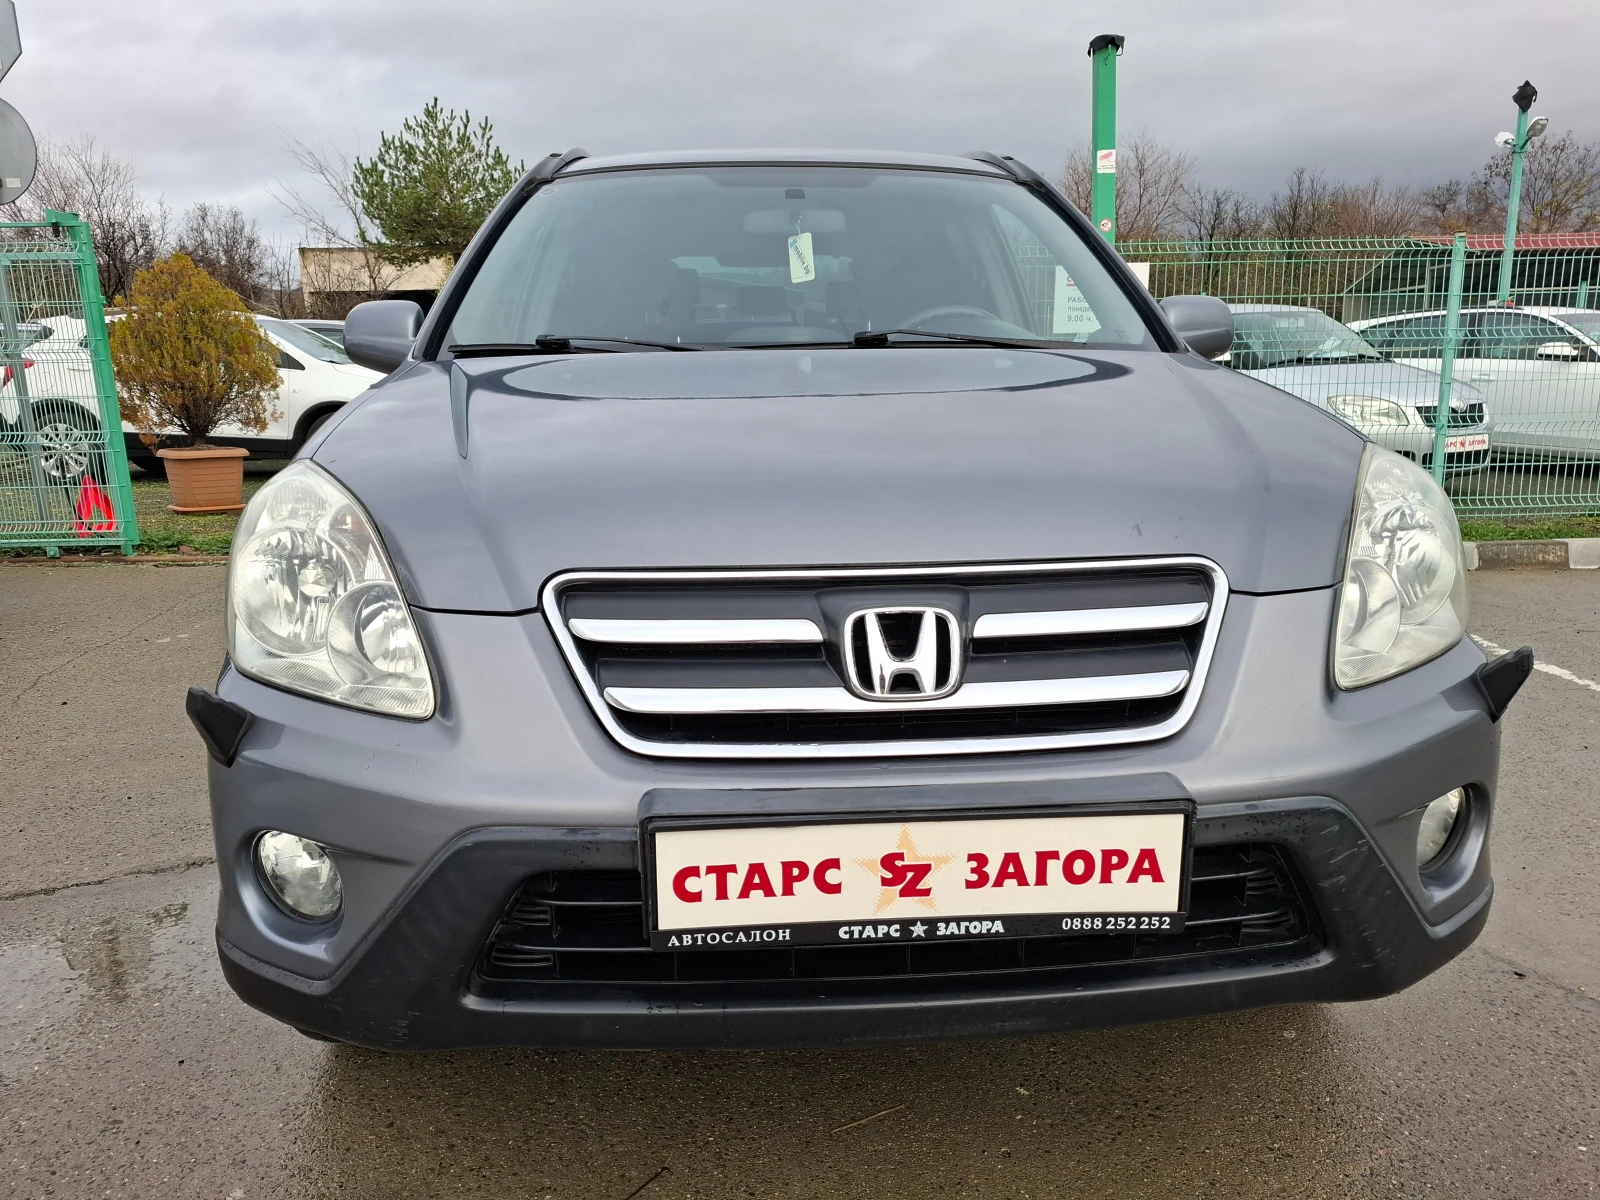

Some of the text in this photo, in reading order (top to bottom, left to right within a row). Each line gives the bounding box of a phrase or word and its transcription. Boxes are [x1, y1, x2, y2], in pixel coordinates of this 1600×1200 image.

[793, 244, 811, 275] mobile.bg
[1067, 315, 1084, 323] 9.00
[672, 848, 1165, 903] СТАРС SZ ЗАГОРА
[667, 928, 791, 947] АВТОСАЛОН
[838, 924, 900, 939] СТАРС
[936, 920, 1005, 936] ЗАГОРА
[1061, 917, 1103, 930] 0888
[1105, 916, 1137, 930] 252
[1139, 916, 1171, 929] 252
